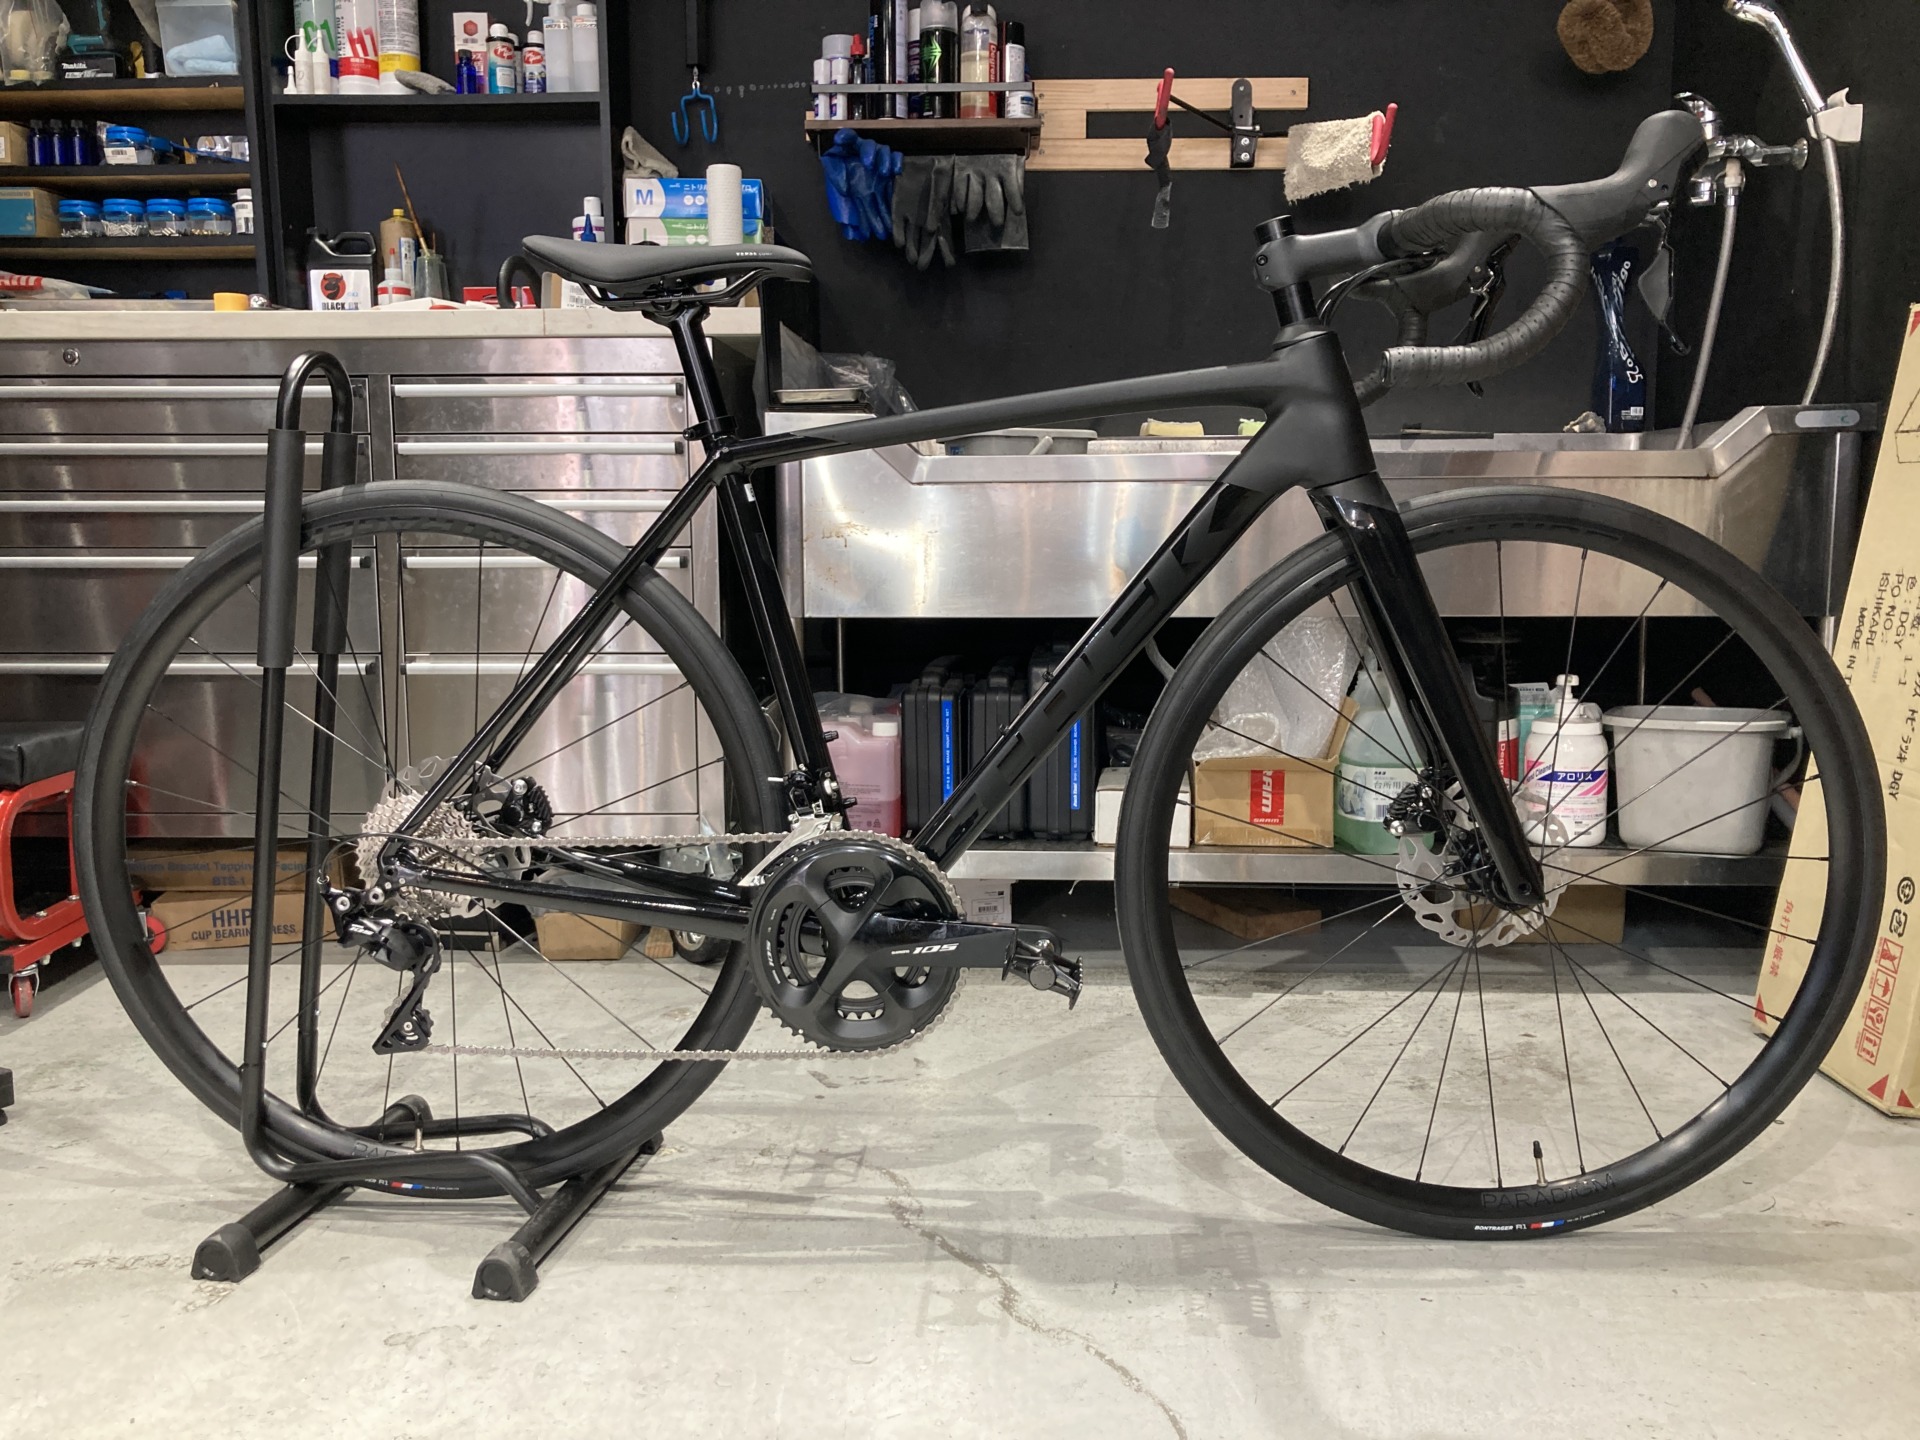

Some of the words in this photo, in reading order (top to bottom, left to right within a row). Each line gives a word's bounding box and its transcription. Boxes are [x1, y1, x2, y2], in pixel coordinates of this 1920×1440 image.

[346, 25, 378, 58] H1
[635, 188, 653, 206] M
[321, 302, 346, 311] BLACK
[1890, 573, 1905, 598] PO
[1865, 572, 1891, 647] ISHIKARI
[1851, 606, 1868, 651] MADE
[1893, 610, 1910, 649] DGY
[1846, 655, 1857, 670] IN
[1888, 769, 1904, 801] DGY
[191, 930, 212, 941] CUP
[215, 927, 251, 940] BEARIN
[271, 924, 297, 935] RESS
[912, 942, 960, 955] 105
[1482, 1173, 1612, 1209] PARADIGM
